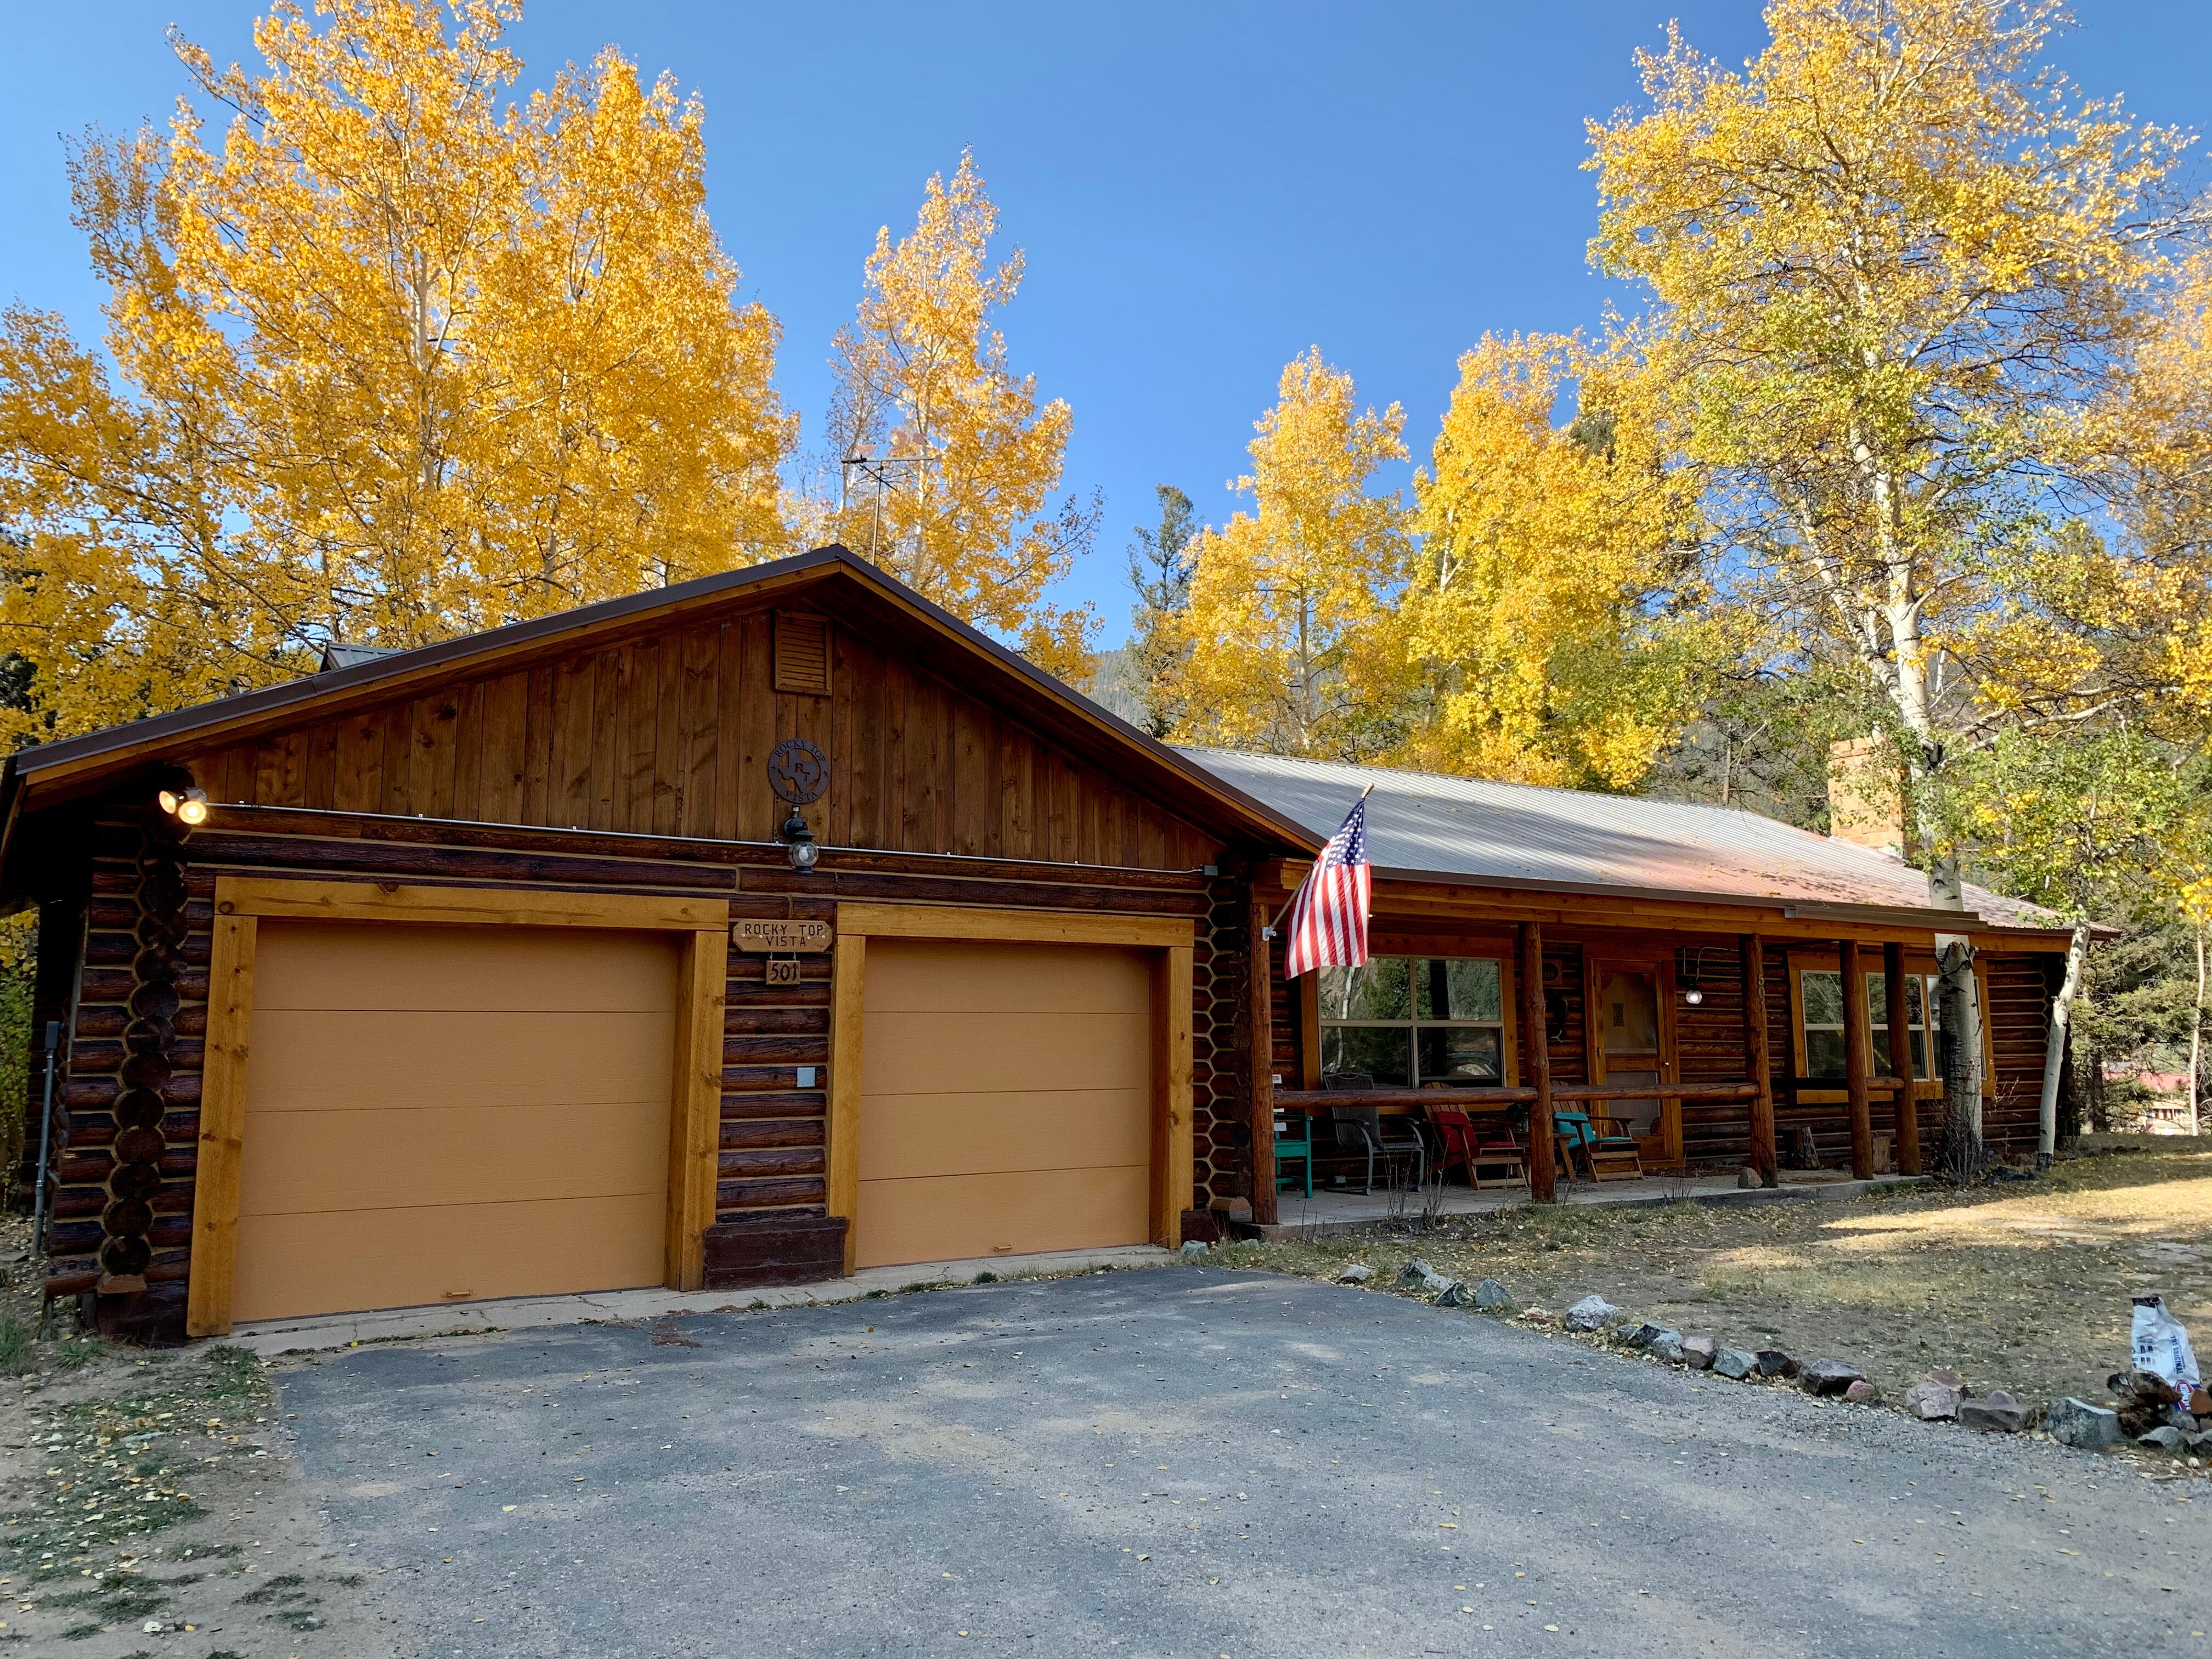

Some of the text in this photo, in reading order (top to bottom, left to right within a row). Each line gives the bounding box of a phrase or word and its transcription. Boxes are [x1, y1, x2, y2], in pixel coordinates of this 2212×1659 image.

[774, 740, 826, 761] ROCKY TOP
[786, 789, 818, 802] VISTA
[745, 923, 823, 936] ROCKY TOP
[766, 936, 806, 947] VISTA
[770, 963, 797, 981] 501
[2170, 1335, 2178, 1346] THE
[2172, 1347, 2183, 1374] ORIGINAL
